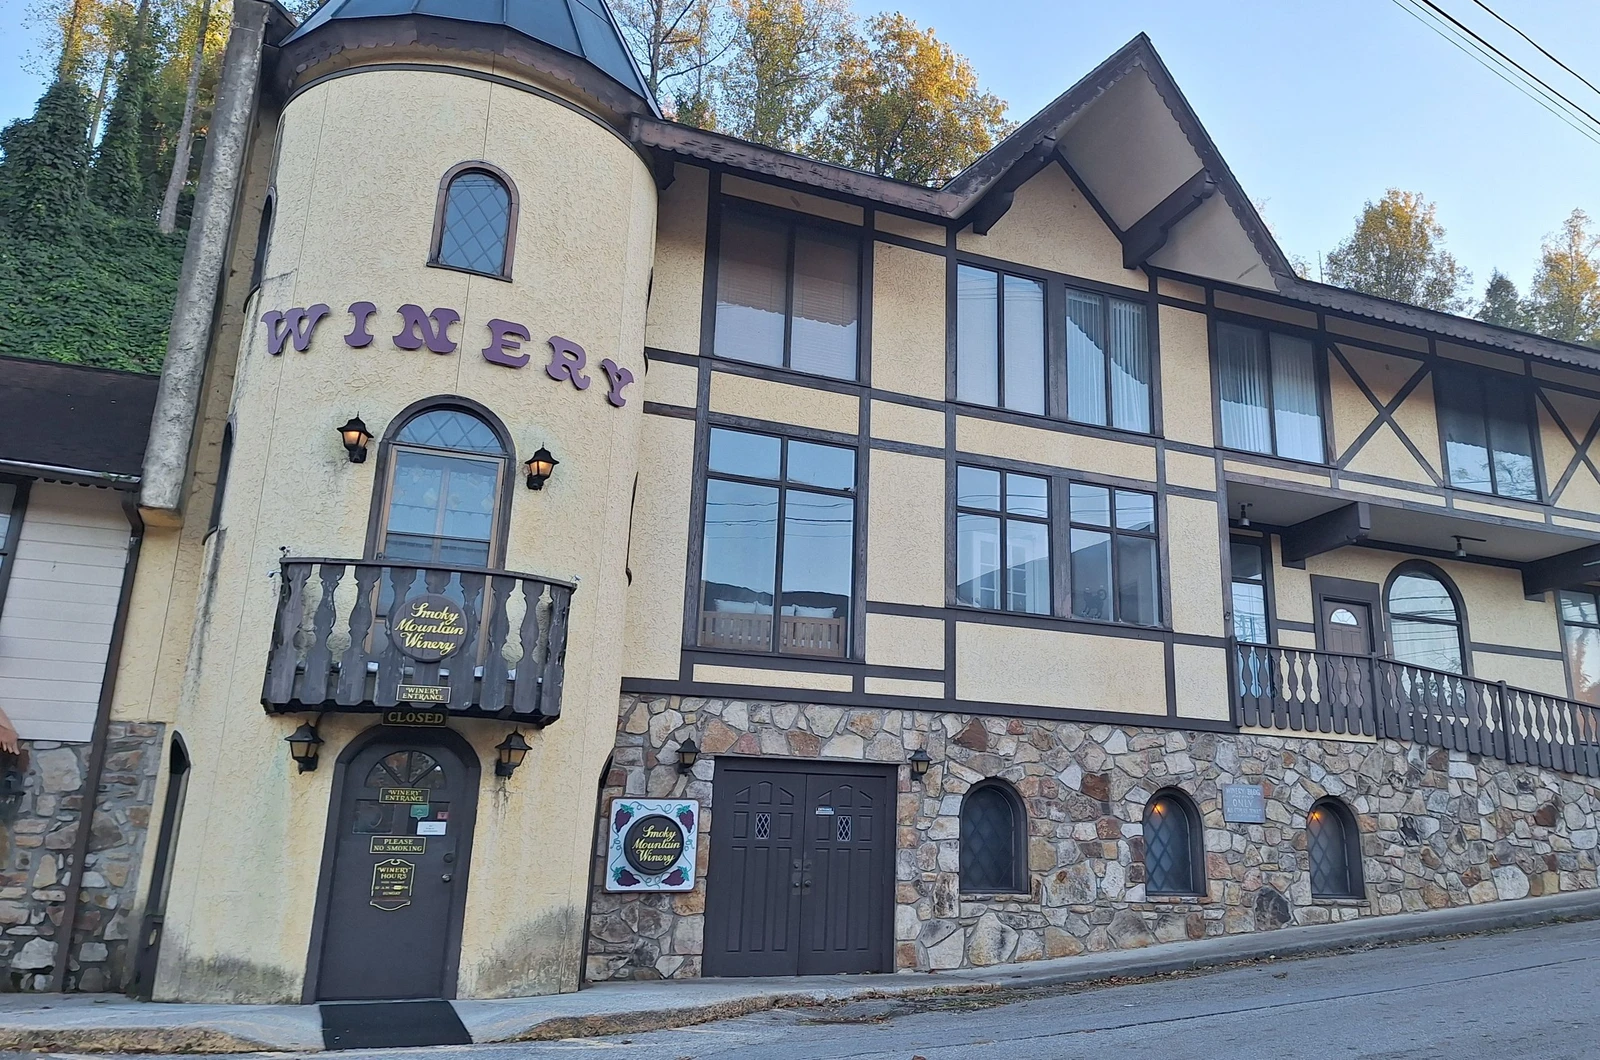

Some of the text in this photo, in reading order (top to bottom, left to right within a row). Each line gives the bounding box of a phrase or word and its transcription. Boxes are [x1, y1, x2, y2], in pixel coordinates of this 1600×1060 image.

[260, 301, 635, 408] WINERY
[410, 602, 459, 625] Smoky
[394, 618, 464, 635] Mountain
[400, 632, 457, 655] Winery
[402, 693, 444, 701] ENTRANCE
[387, 711, 444, 724] CLOSED
[1232, 799, 1253, 808] ONLY
[643, 825, 676, 841] Smoky
[632, 838, 680, 849] Mountain
[636, 849, 674, 865] Winery
